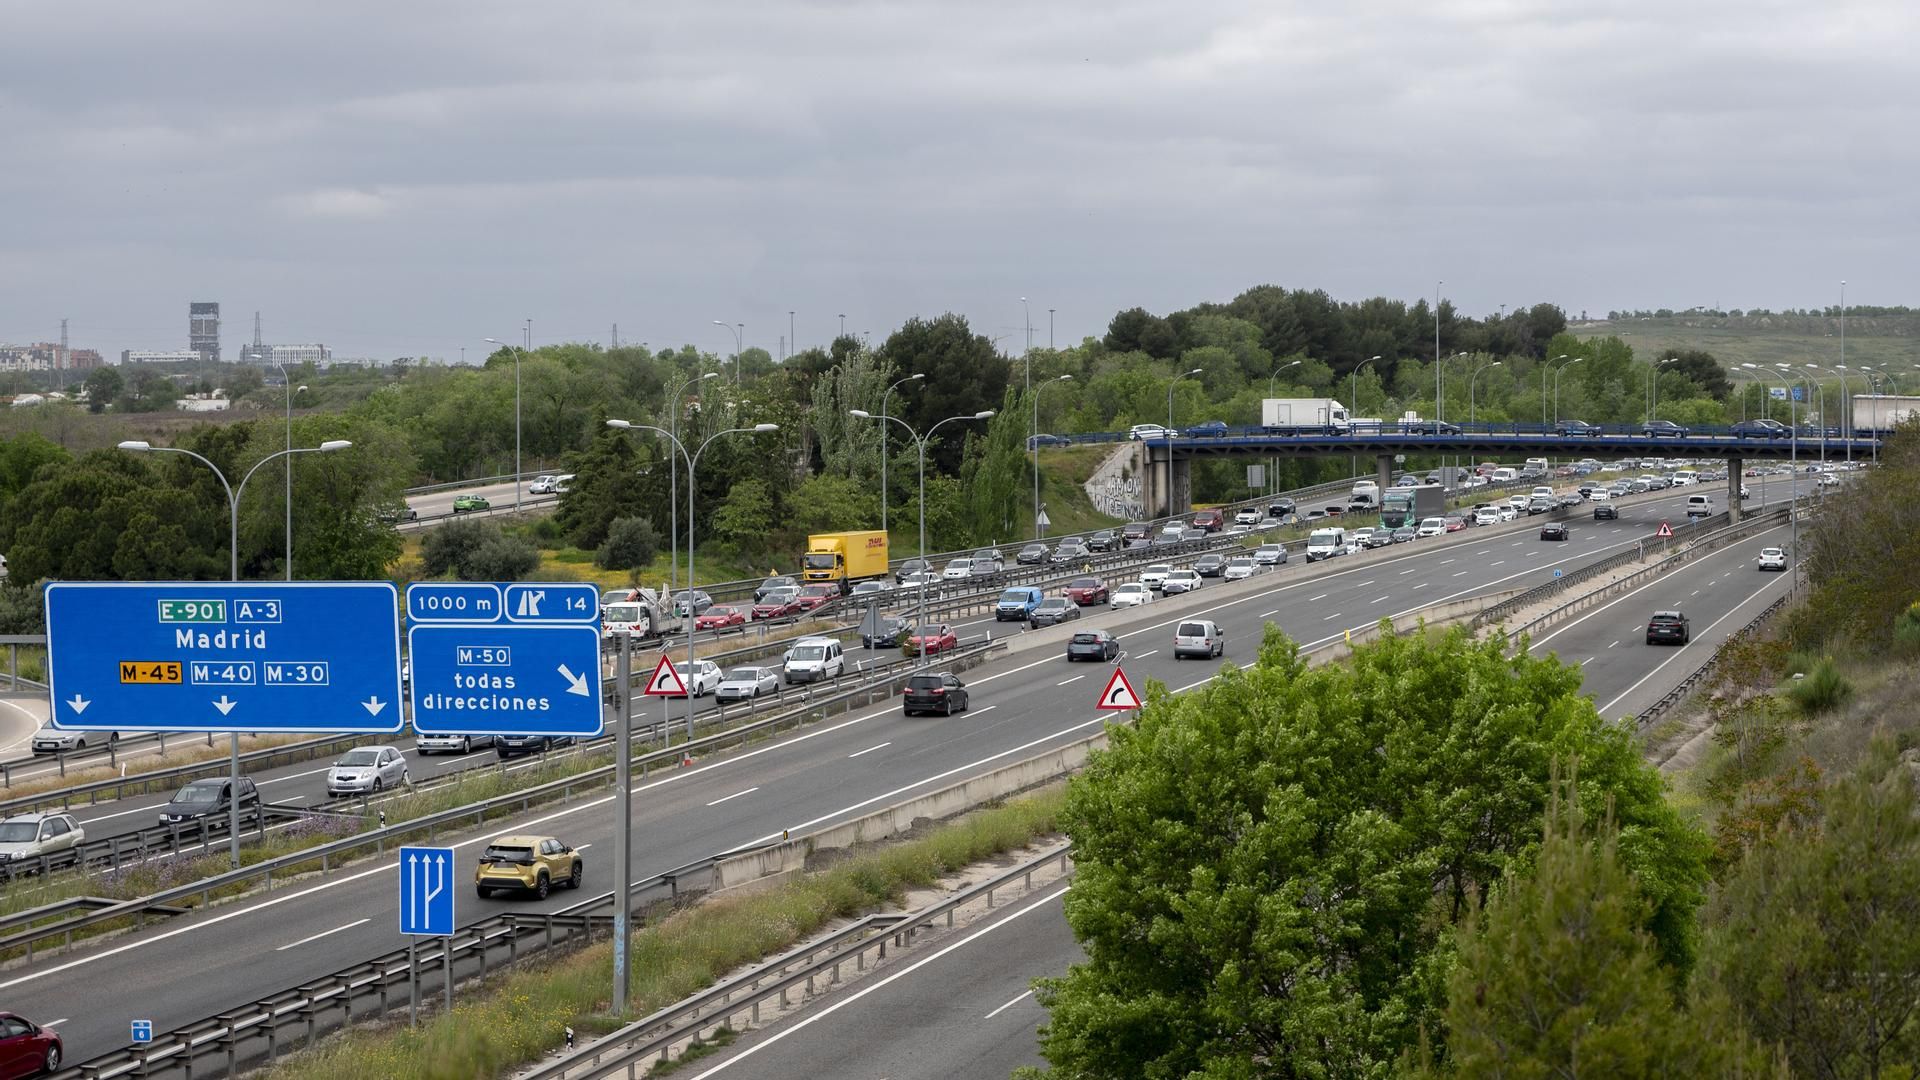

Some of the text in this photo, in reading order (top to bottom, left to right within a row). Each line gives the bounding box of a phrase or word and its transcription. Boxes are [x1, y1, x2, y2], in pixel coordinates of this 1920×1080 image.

[162, 603, 278, 619] E-901 A-3
[419, 597, 491, 610] 1000 m
[566, 597, 586, 610] 14
[176, 629, 266, 648] Madrid
[459, 650, 507, 663] M-50
[123, 666, 323, 681] M-45 M-40 M-30
[455, 674, 515, 689] todas
[423, 695, 549, 711] direcciones
